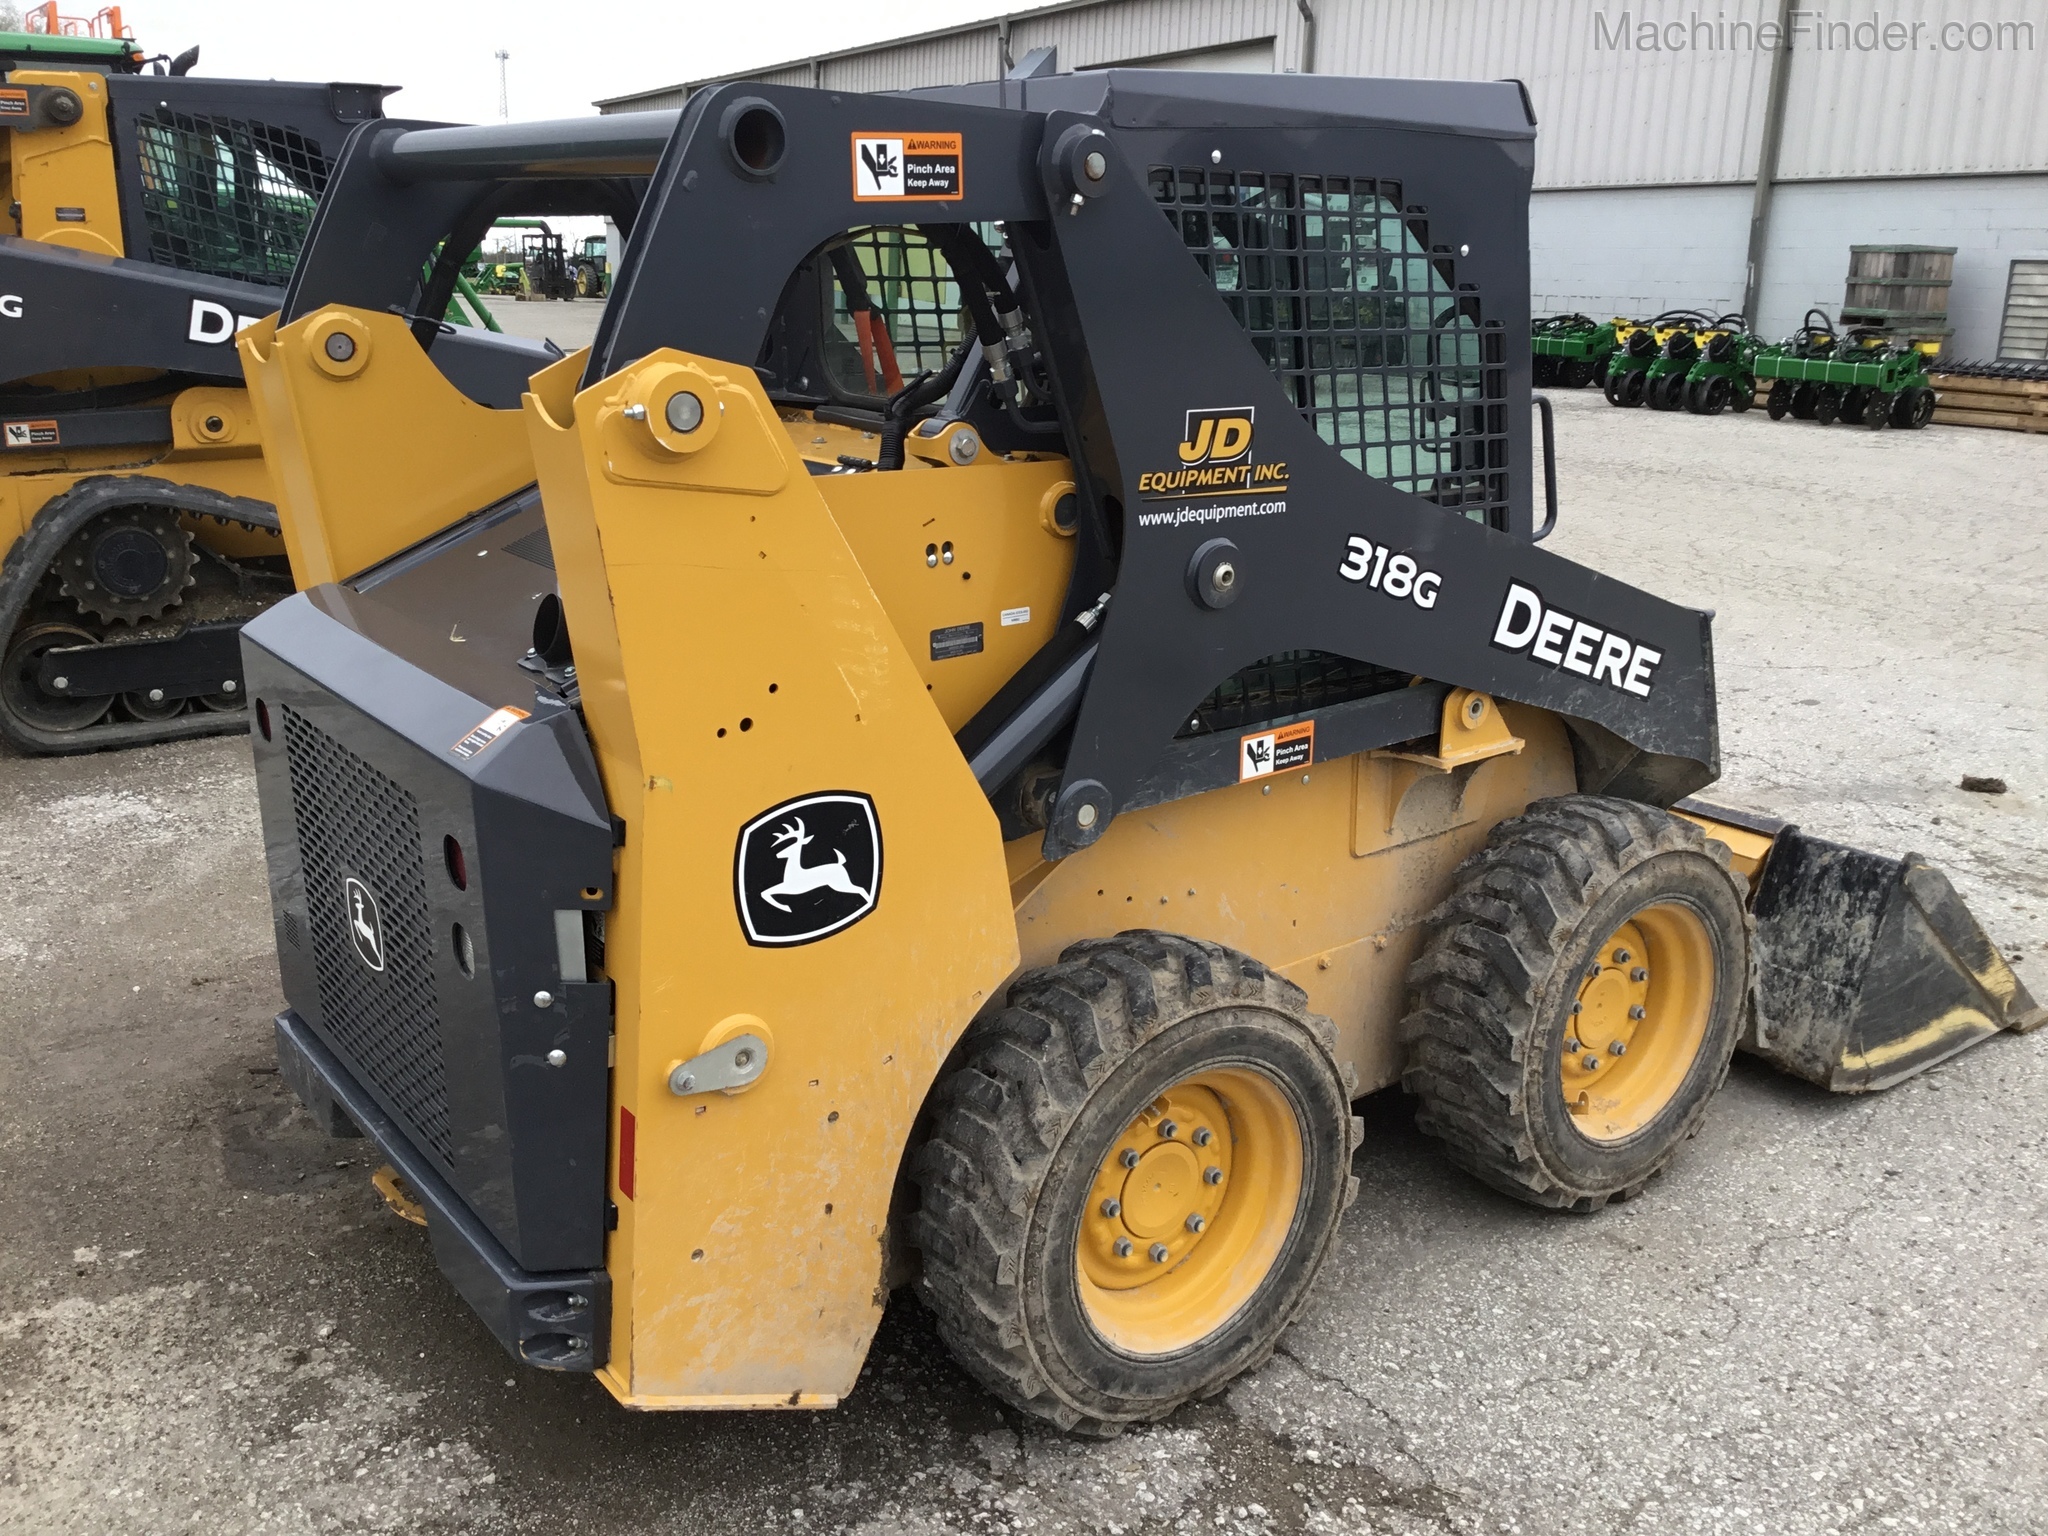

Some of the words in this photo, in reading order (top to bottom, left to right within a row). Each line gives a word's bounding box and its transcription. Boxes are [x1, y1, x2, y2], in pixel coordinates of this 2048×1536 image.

[916, 140, 957, 150] WARNING
[907, 163, 931, 174] Pinch
[934, 164, 956, 174] Area
[907, 178, 927, 189] Keep
[928, 178, 950, 189] Away
[1178, 417, 1253, 466] JD
[1138, 465, 1252, 492] EQUIPMENT
[1253, 462, 1290, 482] INC.
[1138, 501, 1287, 527] www.jdequipment.com
[1338, 535, 1443, 610] 318G
[1492, 582, 1663, 698] DEERE
[1282, 726, 1311, 738] WARNING
[1276, 746, 1294, 757] Pinch
[1294, 743, 1309, 752] Area
[1275, 757, 1290, 766] Keep
[1289, 754, 1305, 763] Away
